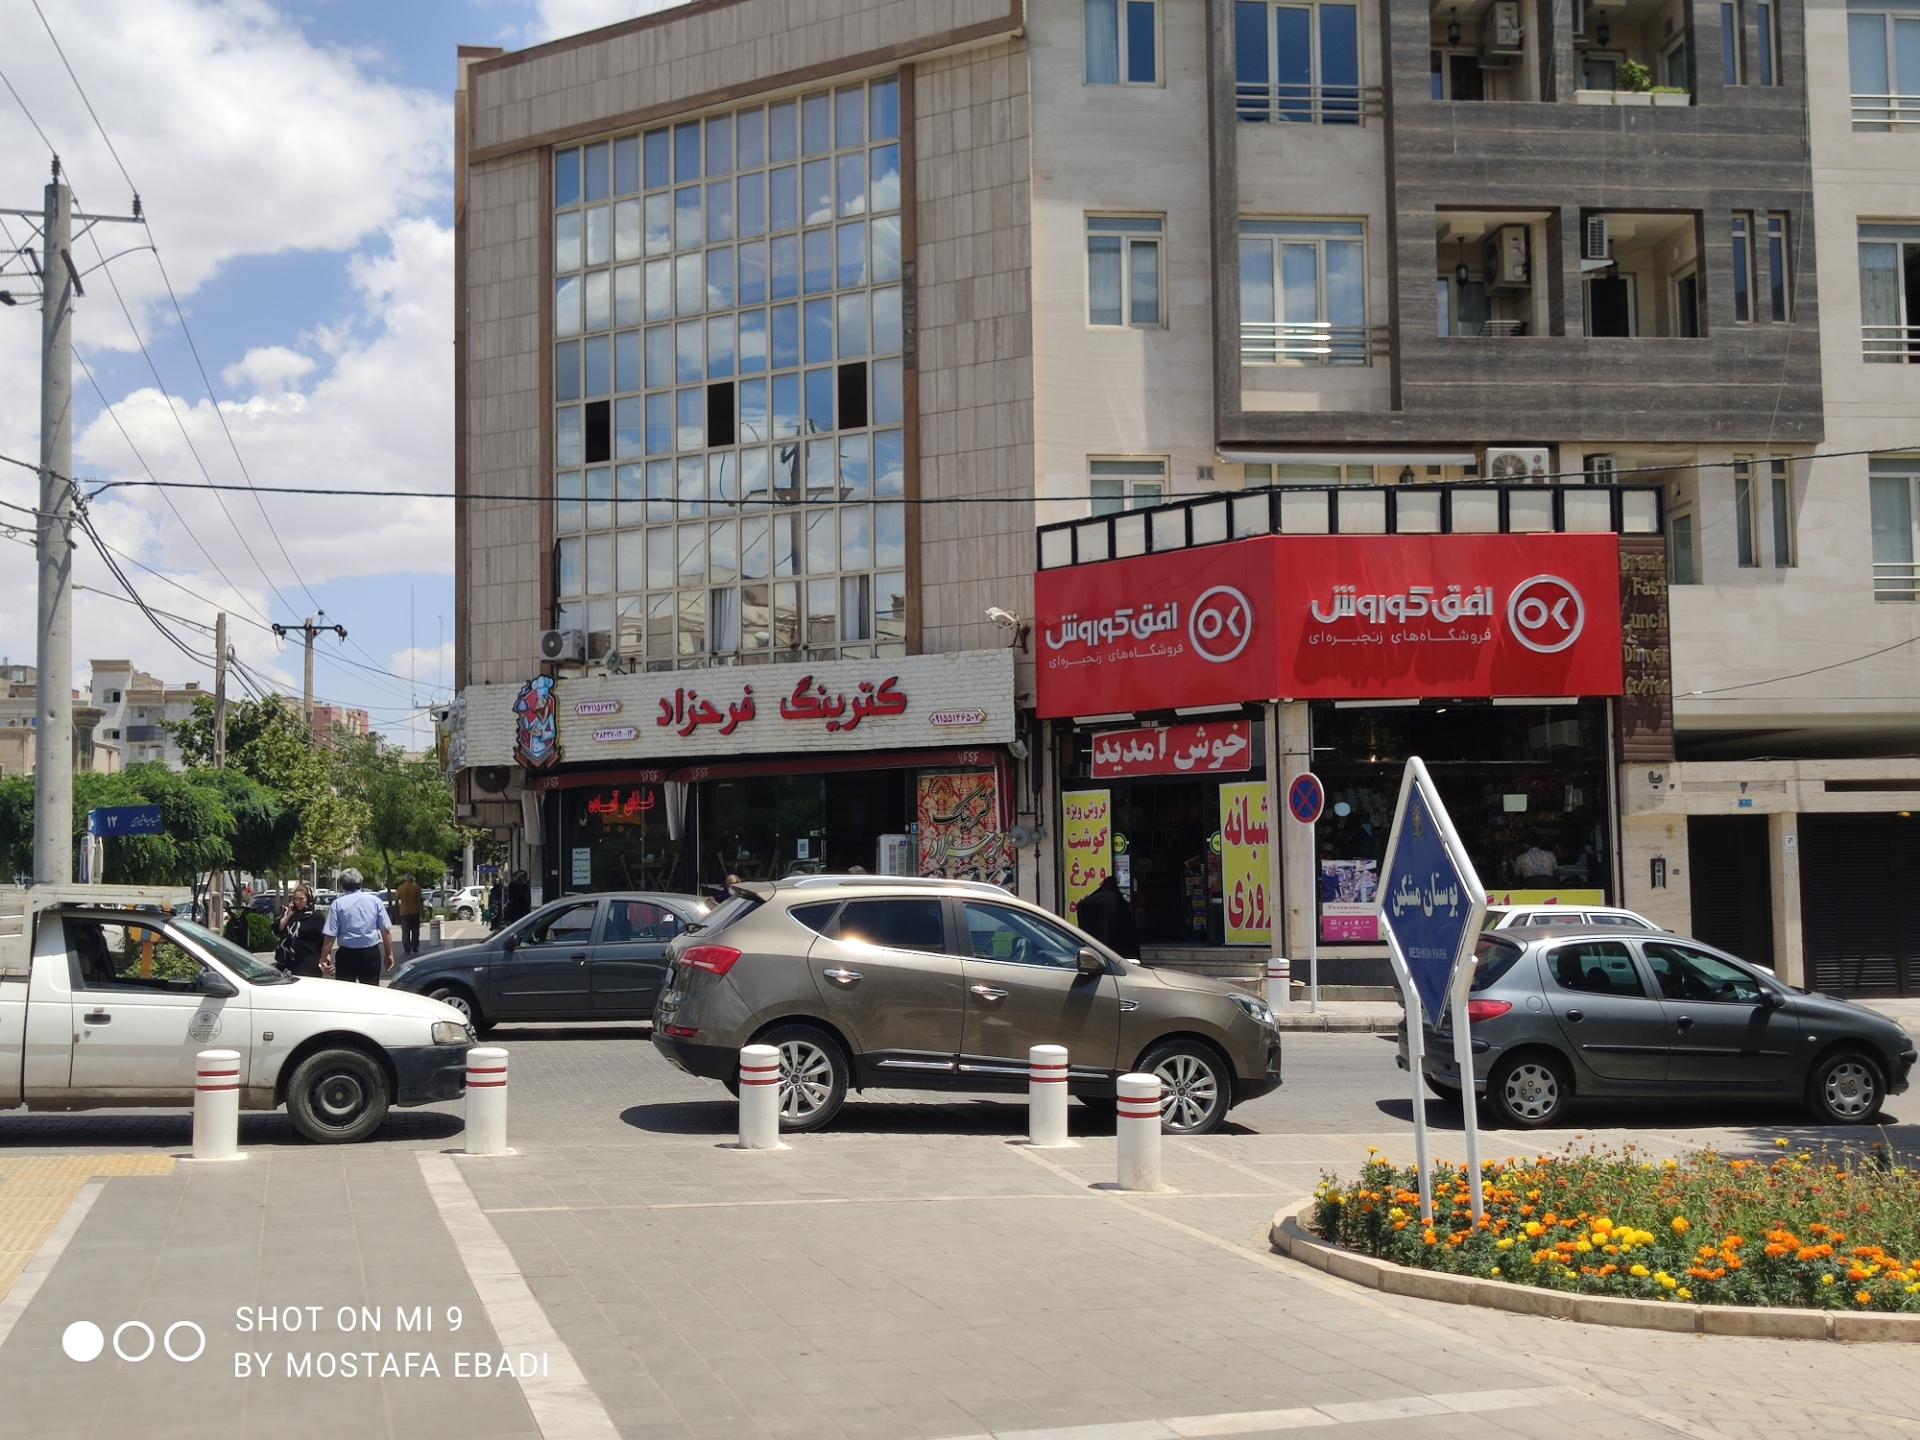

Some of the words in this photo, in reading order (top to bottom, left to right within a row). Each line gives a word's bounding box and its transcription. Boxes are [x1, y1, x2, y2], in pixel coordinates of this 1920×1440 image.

[1431, 585, 1493, 623] افق
[1631, 577, 1667, 596] Fast
[1131, 602, 1178, 640] افق
[656, 684, 756, 737] فرحزاد
[780, 675, 908, 732] کترینگ
[1095, 726, 1171, 772] آمدید
[1173, 722, 1248, 770] خوش
[1084, 799, 1107, 819] فروش
[1067, 826, 1108, 855] گوشت
[1069, 857, 1095, 887] مرغ
[1392, 873, 1421, 917] مشکین
[1423, 872, 1458, 918] بوستان
[1432, 947, 1449, 960] PARK
